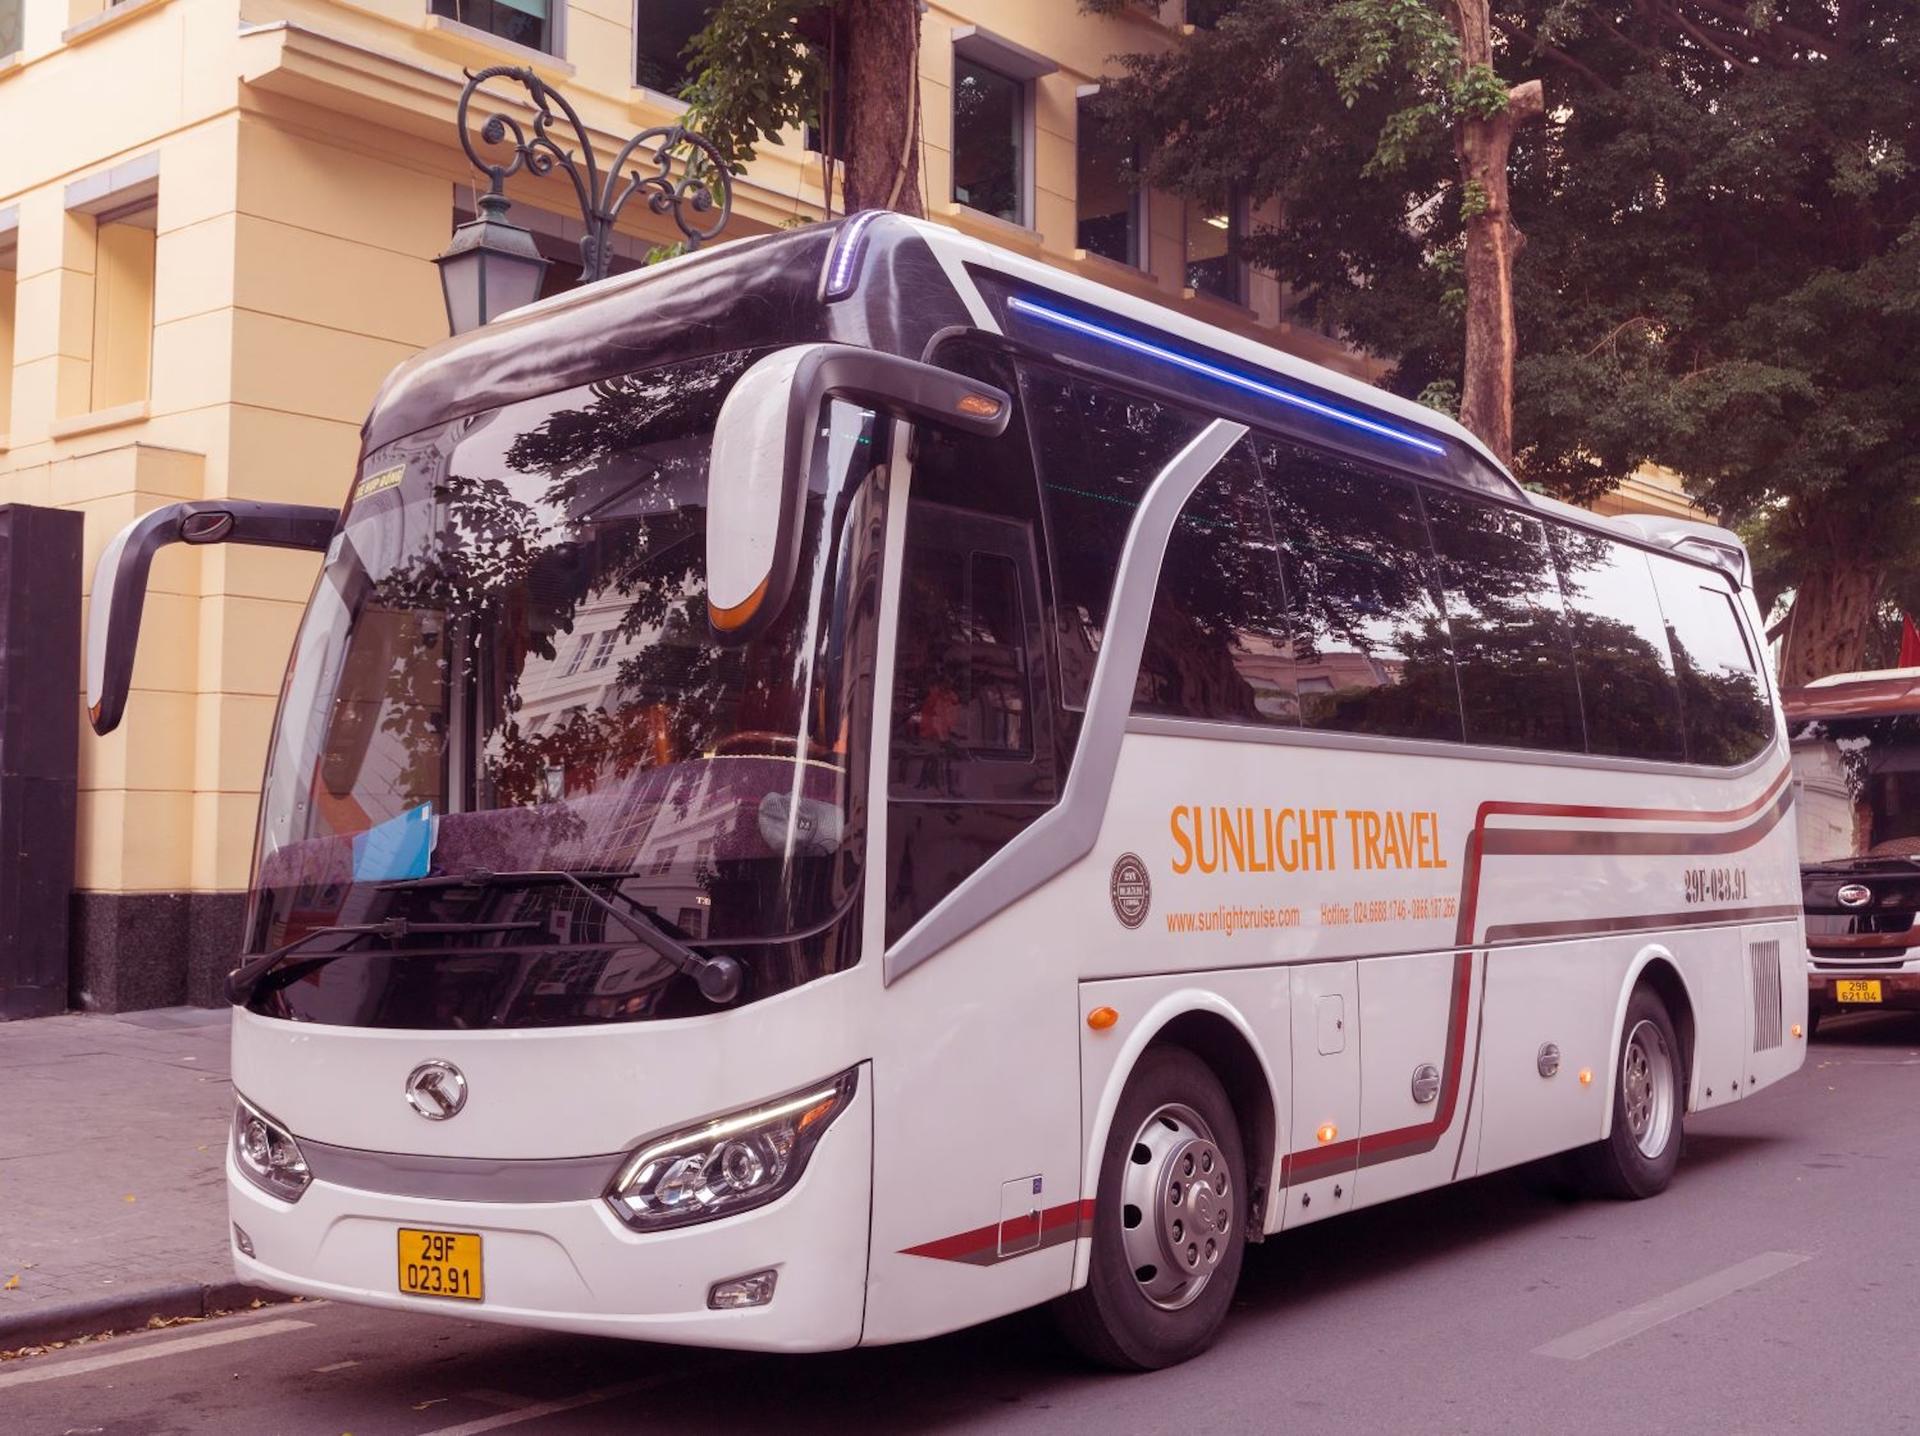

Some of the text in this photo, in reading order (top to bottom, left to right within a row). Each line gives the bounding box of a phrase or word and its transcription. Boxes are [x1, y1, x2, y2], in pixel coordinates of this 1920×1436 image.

[1169, 804, 1447, 874] SUNLIGHT TRAVEL
[1684, 867, 1748, 903] 29F-023.91
[1166, 904, 1300, 936] www.sunlightcruise.com
[1849, 982, 1868, 991] 29B
[421, 1235, 456, 1262] 29F
[408, 1264, 470, 1295] 023.91
